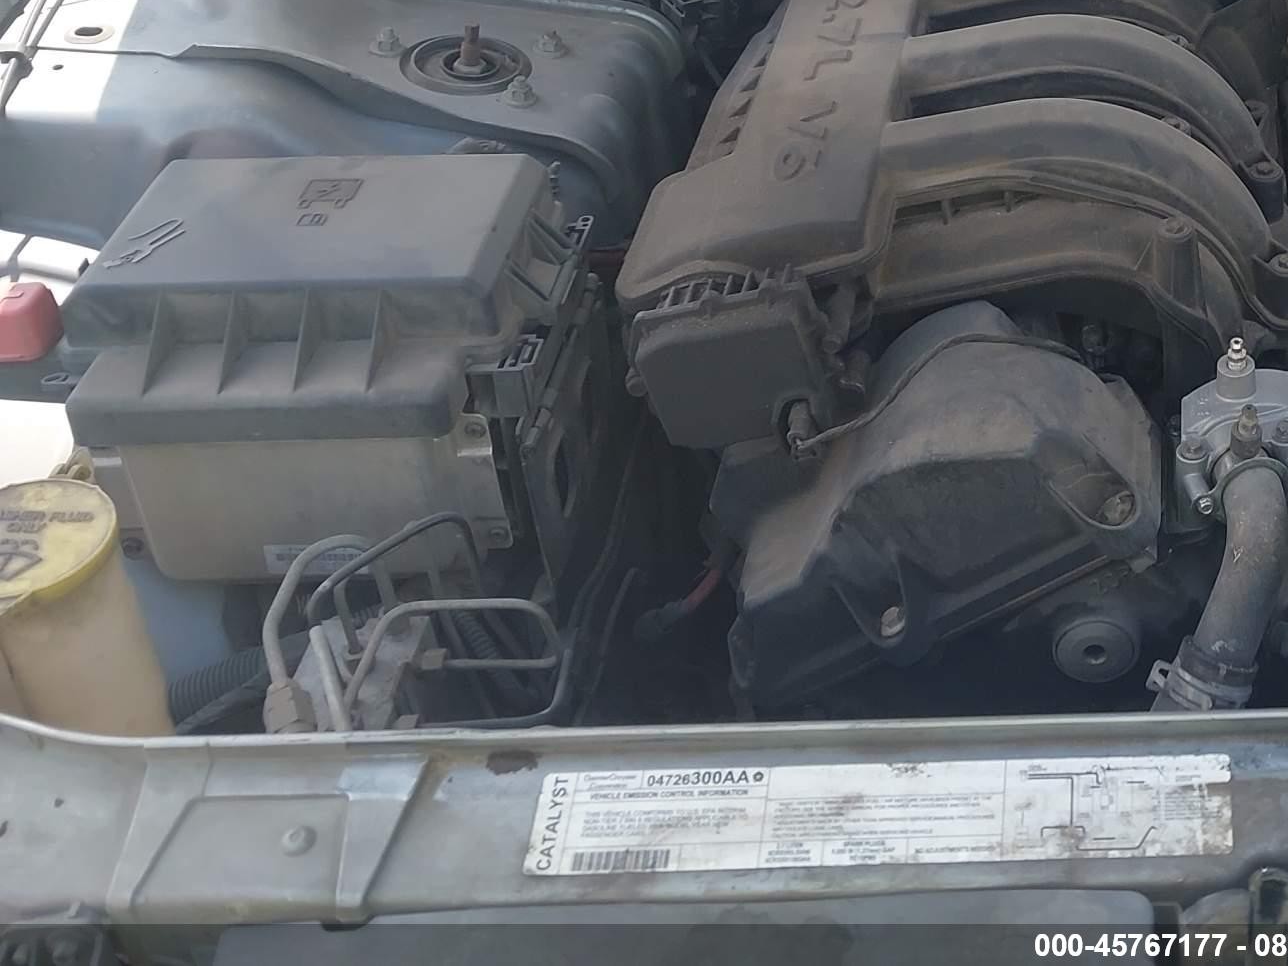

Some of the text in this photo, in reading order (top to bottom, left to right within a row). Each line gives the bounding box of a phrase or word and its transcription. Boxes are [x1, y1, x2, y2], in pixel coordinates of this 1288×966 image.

[773, 99, 840, 182] V6
[590, 788, 748, 800] VEHICLE EMISSION CONTROL INFORMATION
[647, 770, 750, 787] 04726300AA
[535, 776, 569, 871] CATALYST
